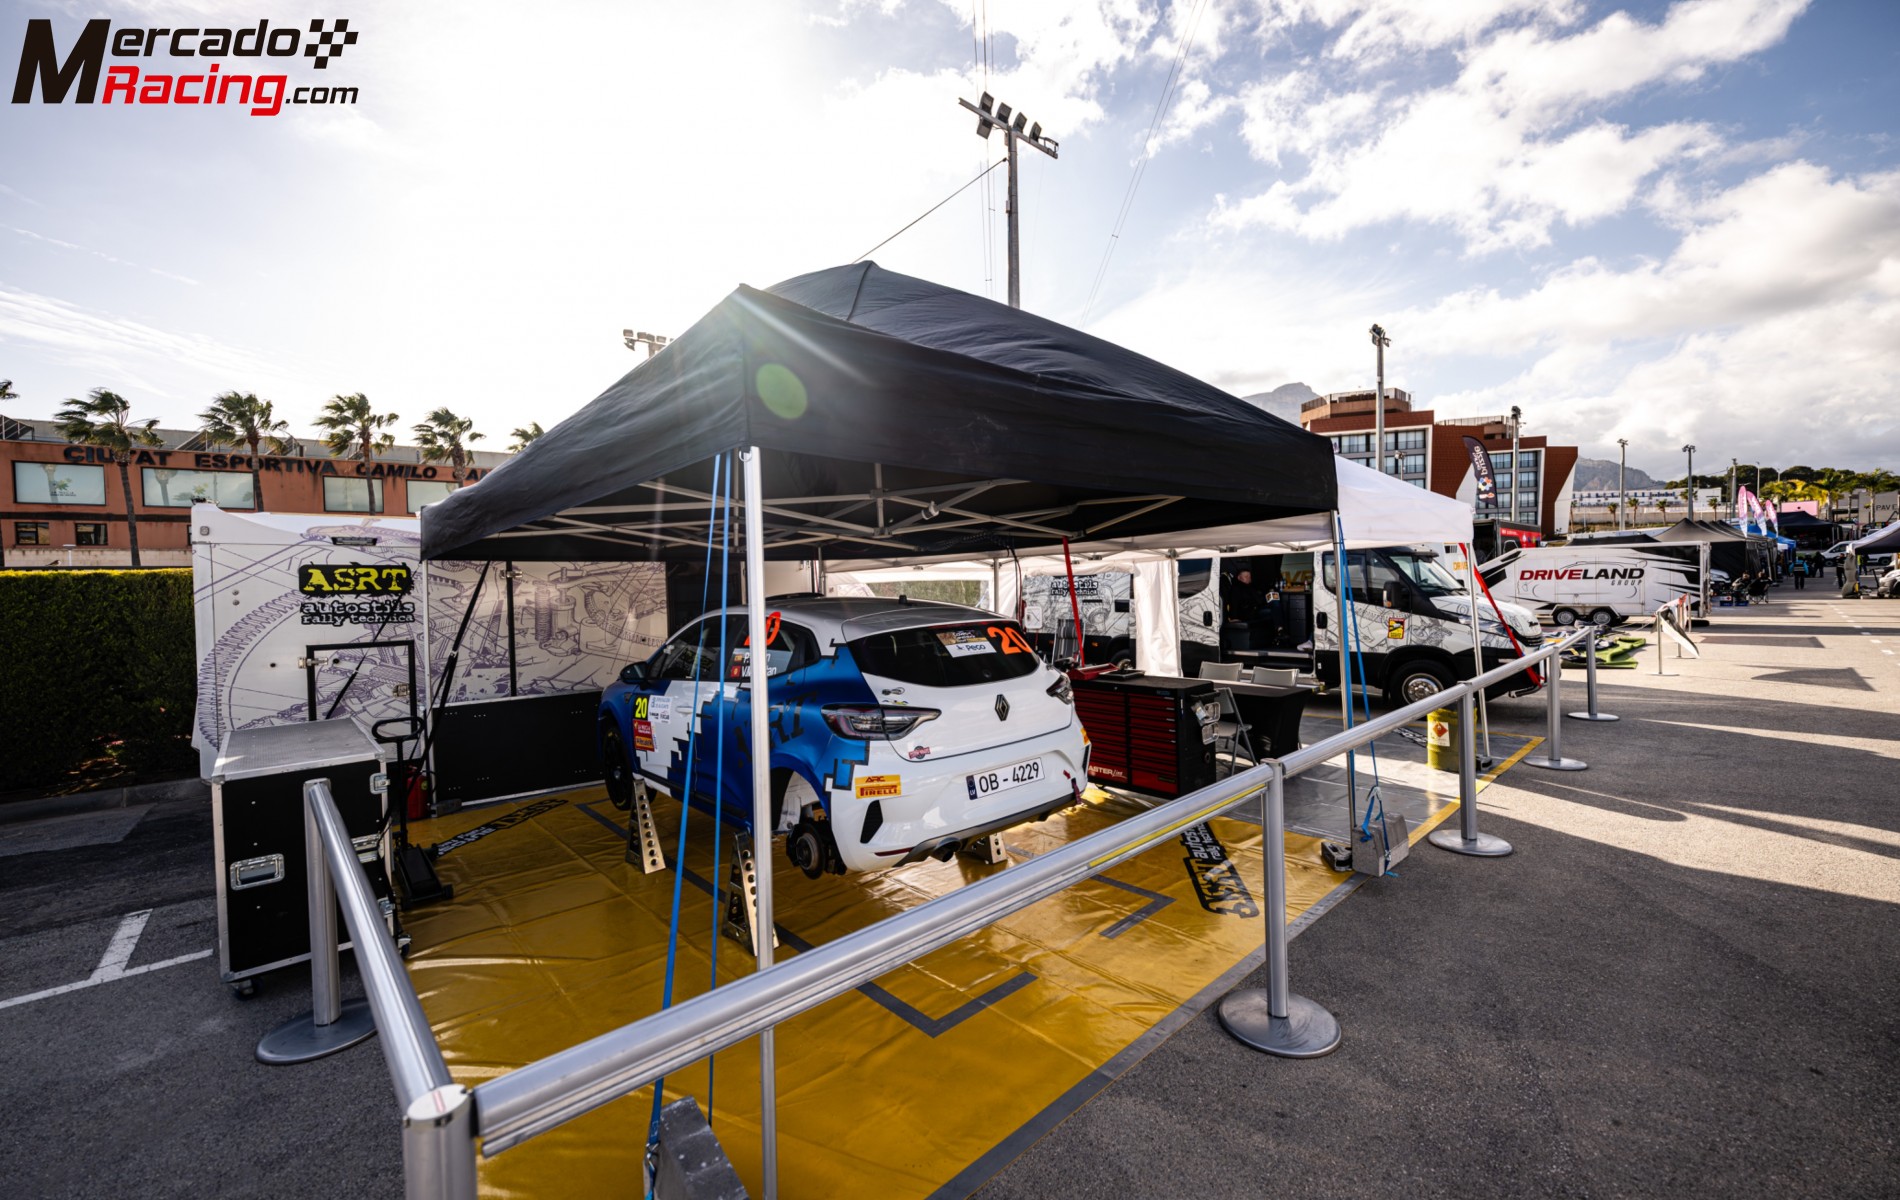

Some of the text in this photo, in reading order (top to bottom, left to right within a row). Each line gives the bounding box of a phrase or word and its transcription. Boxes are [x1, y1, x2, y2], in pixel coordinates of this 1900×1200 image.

[63, 445, 173, 466] CIUAT
[195, 453, 338, 475] ESPORTIVA
[355, 462, 438, 479] CAMILO
[303, 568, 408, 592] ASRT
[1519, 568, 1645, 581] DRIVELAND
[302, 614, 344, 626] rally
[987, 626, 1032, 655] 20
[634, 697, 648, 719] 20
[865, 775, 886, 783] ARC
[978, 773, 1000, 793] OB
[1012, 761, 1039, 783] 4229
[860, 785, 898, 797] PIRELLI
